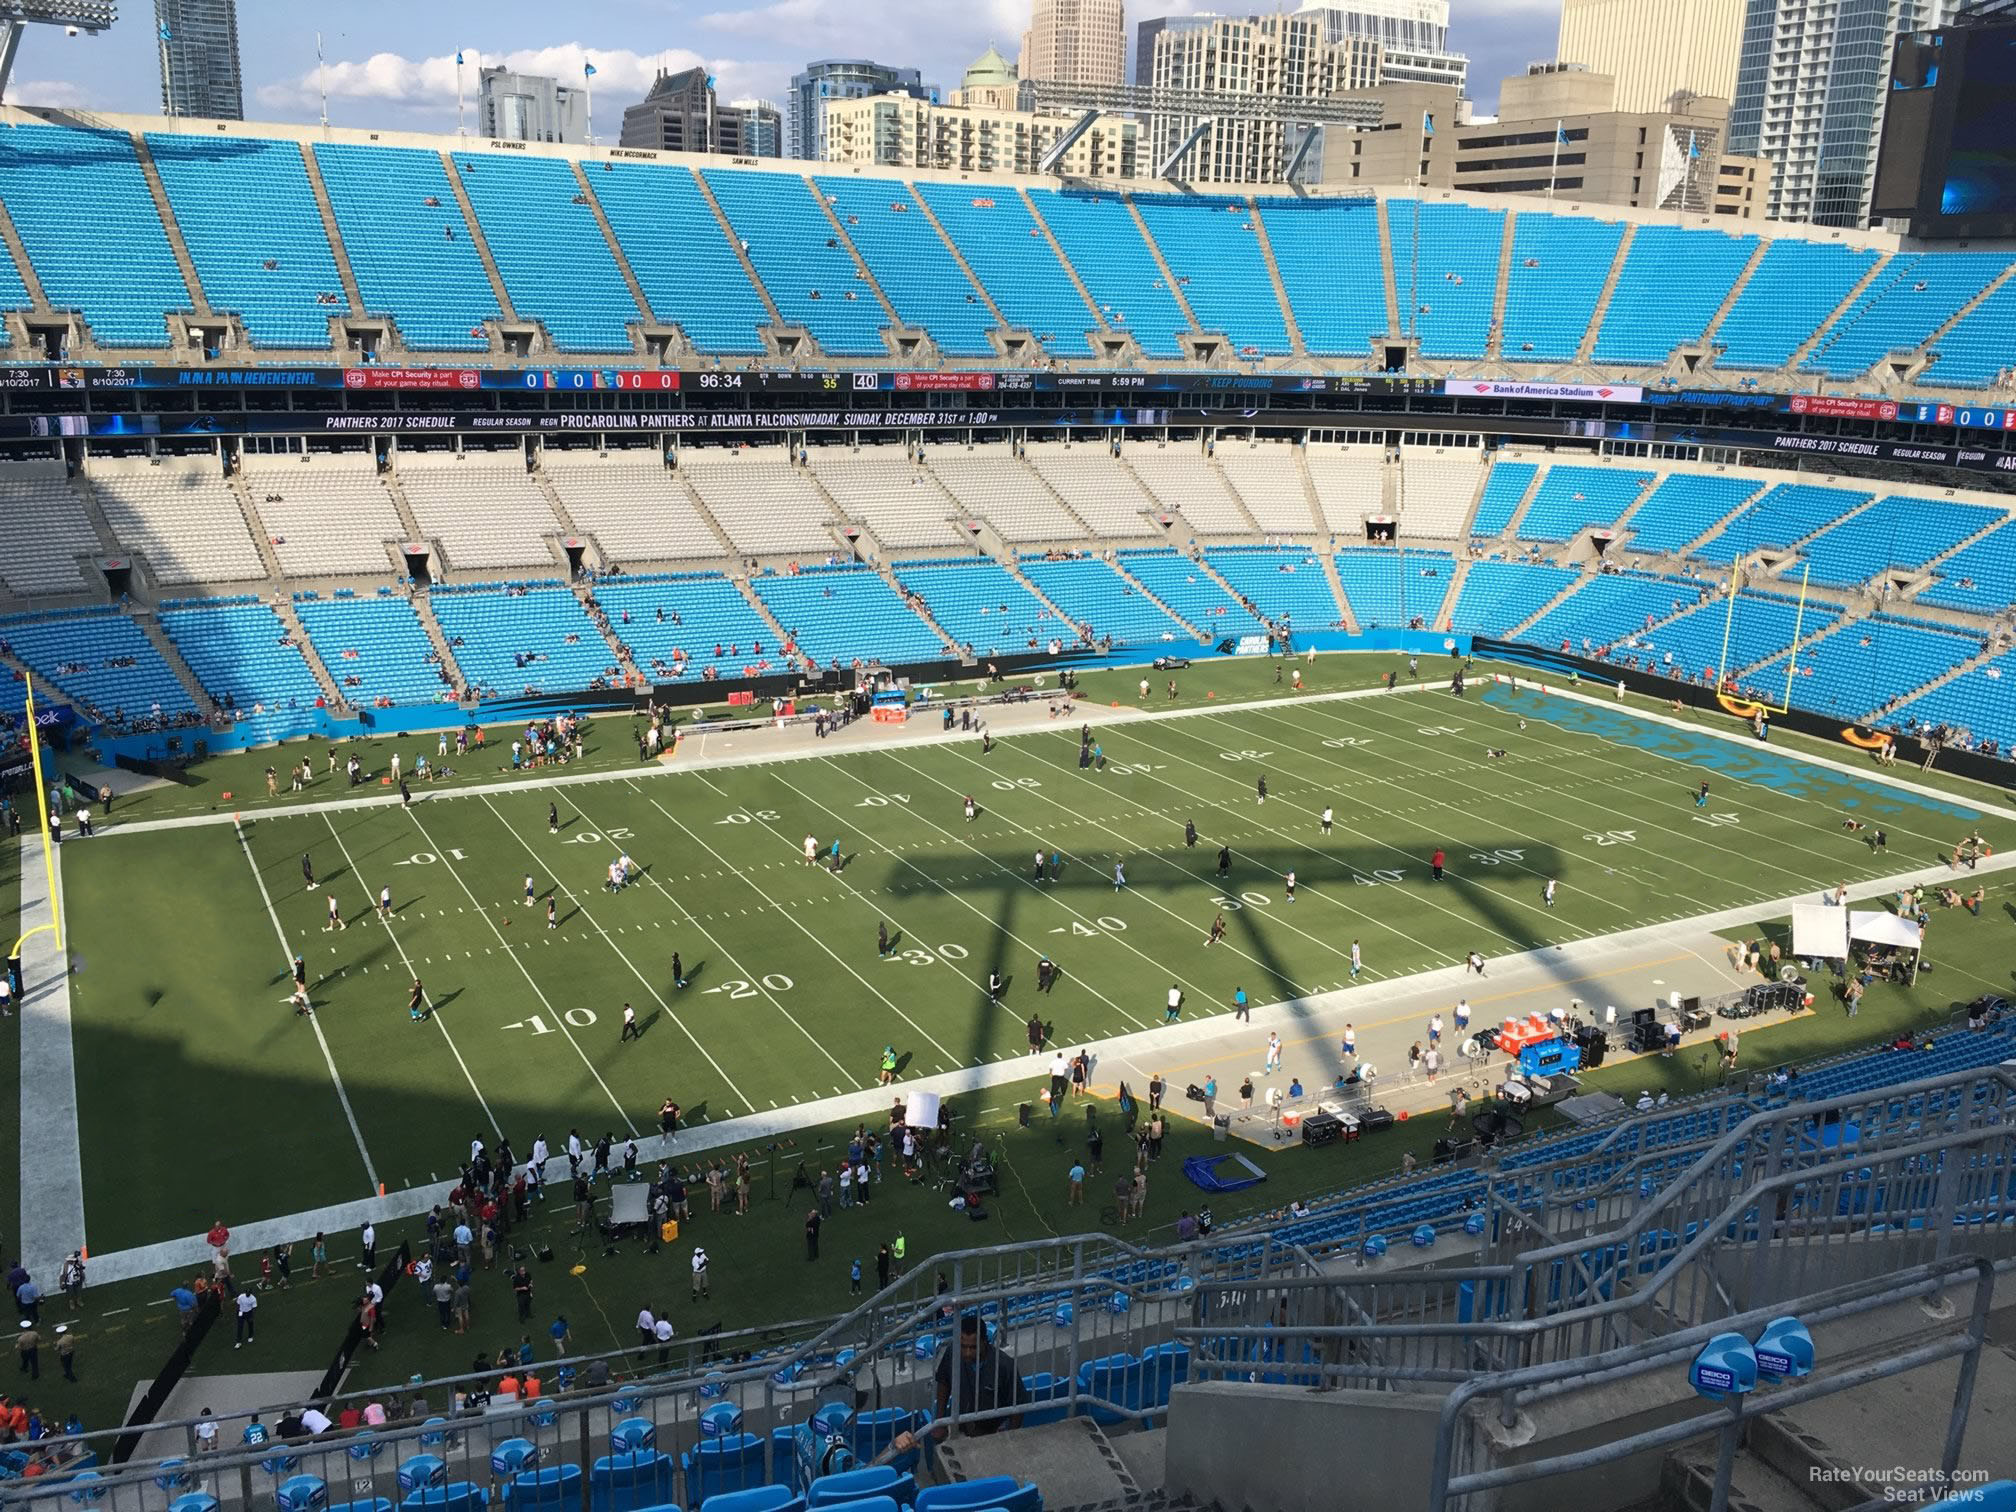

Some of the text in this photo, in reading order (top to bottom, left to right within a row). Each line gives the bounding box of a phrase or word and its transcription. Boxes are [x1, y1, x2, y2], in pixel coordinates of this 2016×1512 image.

[732, 157, 743, 165] SAM
[9, 370, 29, 378] 7:30
[106, 369, 125, 377] 7:30
[405, 371, 432, 379] Security
[439, 371, 453, 379] part
[92, 378, 135, 387] 8/10/2017
[526, 374, 537, 387] 0
[573, 374, 584, 387] 0
[700, 374, 742, 388] 96:34
[823, 378, 837, 389] 35
[857, 375, 874, 388] 40
[1112, 377, 1145, 387] 5:59 PM
[1493, 385, 1515, 394] Bank
[1524, 386, 1558, 396] America
[1559, 387, 1594, 397] Stadium
[1837, 400, 1859, 410] Security
[326, 416, 456, 428] PANTHERS 2017 SCHEDULE
[472, 418, 531, 427] REGULAR SEASON
[641, 414, 695, 428] PANTHERS
[698, 417, 708, 427] AT
[711, 414, 751, 427] ATLANTA
[755, 413, 800, 426] FALCONS
[844, 412, 882, 426] SUNDAY,
[884, 412, 935, 425] DECEMBER
[937, 412, 958, 424] 31ST
[968, 412, 987, 424] 1:00
[988, 414, 998, 422] PM
[1960, 411, 1995, 426] 0 0
[1774, 436, 1880, 456] PANTHERS 2017 SCHEDULE
[1892, 448, 1921, 459] REGULAR
[1921, 451, 1947, 461] SEASON
[991, 776, 1043, 792] 50
[864, 792, 912, 808] 40
[726, 809, 782, 826] 30
[1692, 812, 1739, 828] 10
[576, 827, 636, 847] 20
[1582, 829, 1630, 847] 20
[411, 847, 468, 867] 10
[1468, 848, 1521, 866] 30
[1350, 868, 1399, 888] 40
[1210, 891, 1272, 912] 50
[1069, 916, 1128, 938] 40
[901, 943, 970, 967] 30
[722, 973, 794, 1000] 20
[525, 1007, 598, 1036] 10
[1758, 1353, 1788, 1365] GEICO
[1701, 1369, 1731, 1381] GEICO
[250, 1431, 264, 1445] 22
